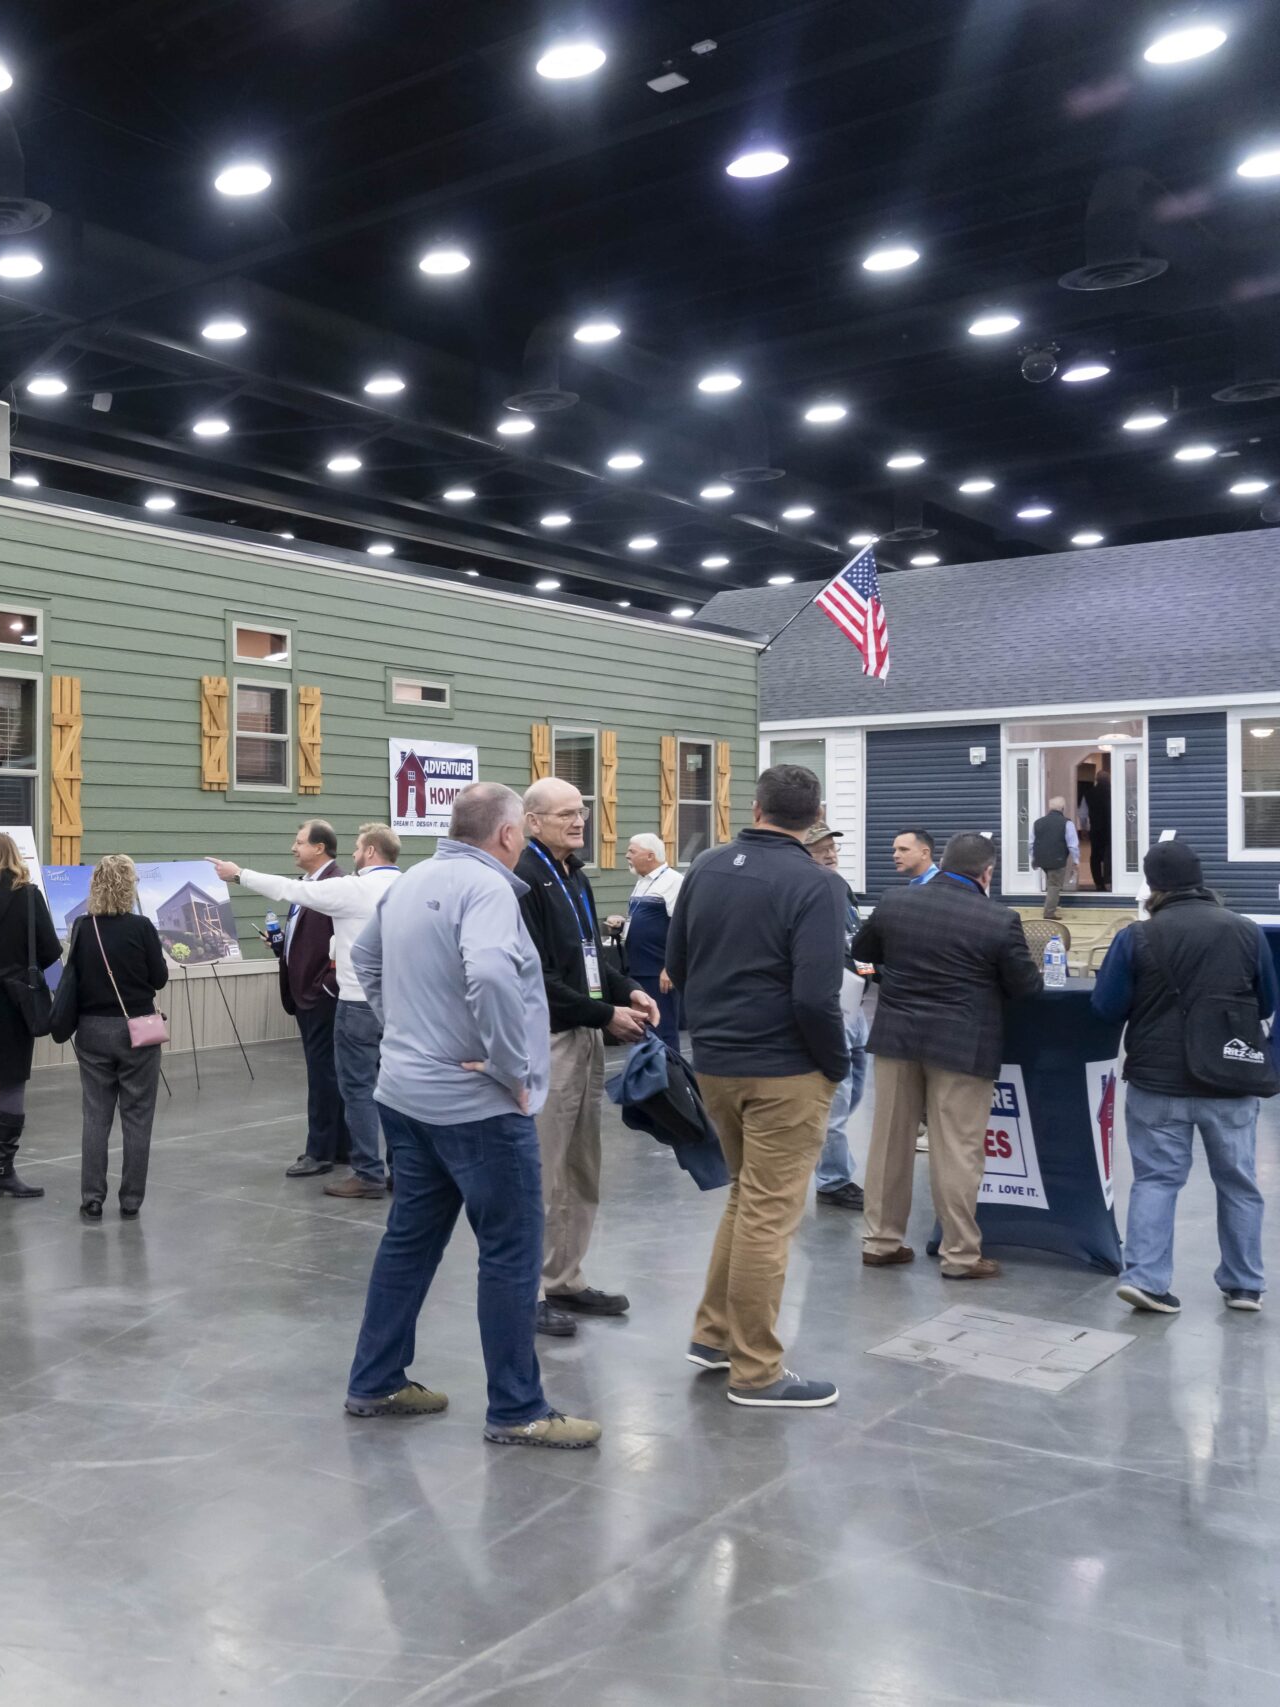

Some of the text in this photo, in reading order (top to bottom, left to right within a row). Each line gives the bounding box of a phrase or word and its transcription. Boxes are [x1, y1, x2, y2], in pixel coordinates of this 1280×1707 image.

[423, 760, 472, 776] ADVENTURE
[429, 787, 460, 806] HOM
[982, 1184, 1039, 1198] IT. LOVE IT.
